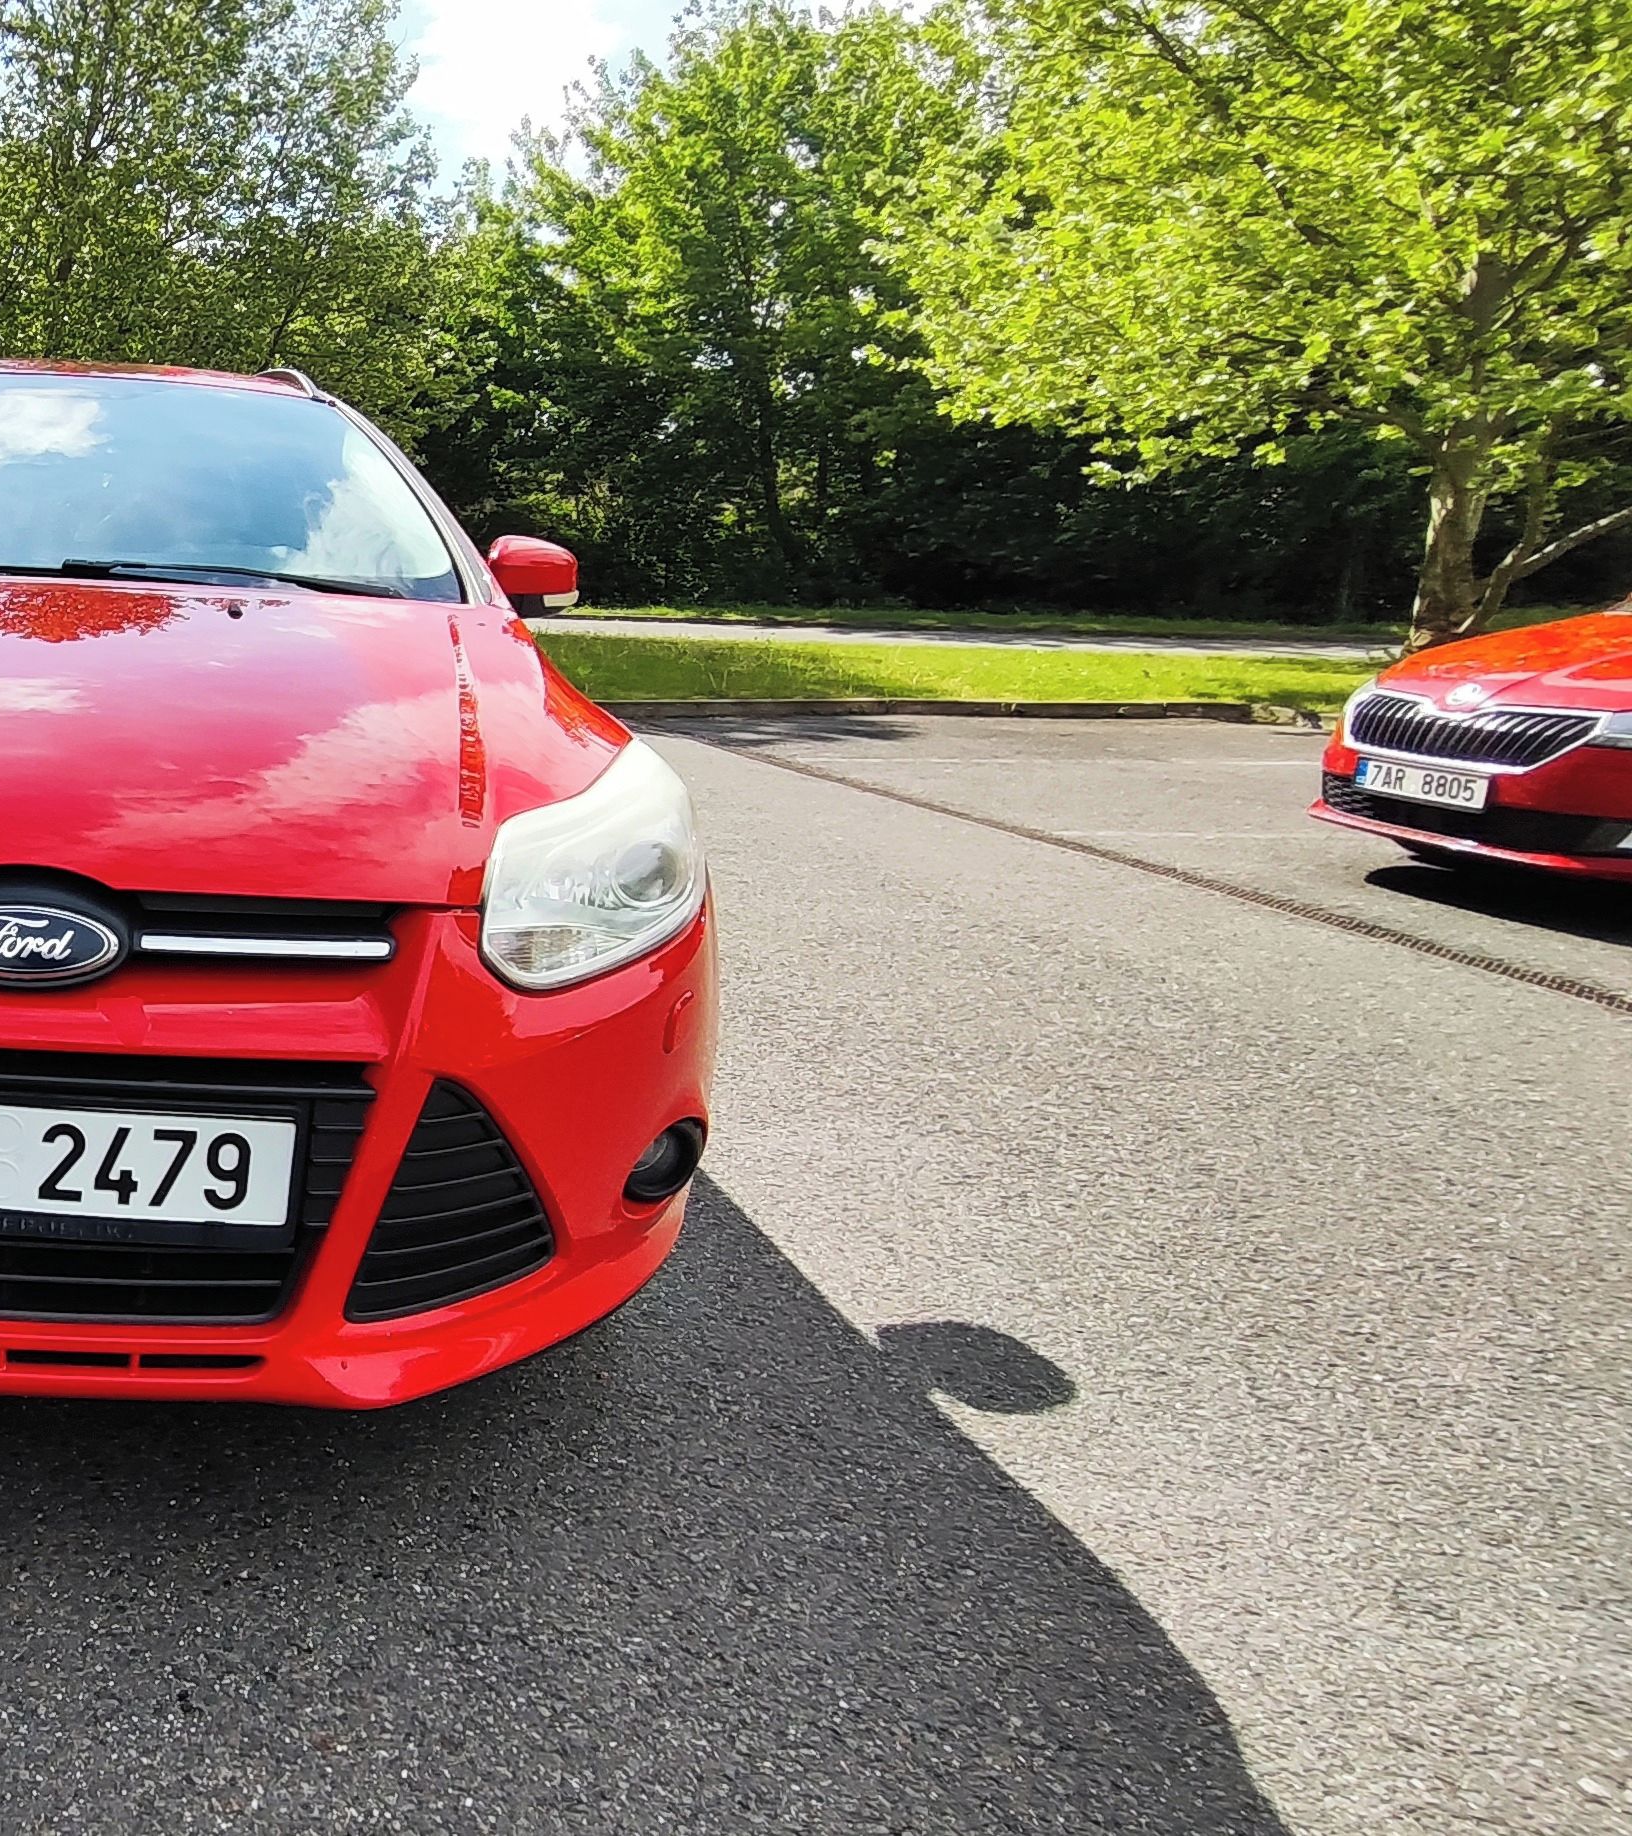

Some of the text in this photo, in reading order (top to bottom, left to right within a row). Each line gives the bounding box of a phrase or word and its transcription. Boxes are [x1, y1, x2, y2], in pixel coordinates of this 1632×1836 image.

[1369, 764, 1478, 802] 7AR 8805
[38, 1123, 252, 1210] 2479
